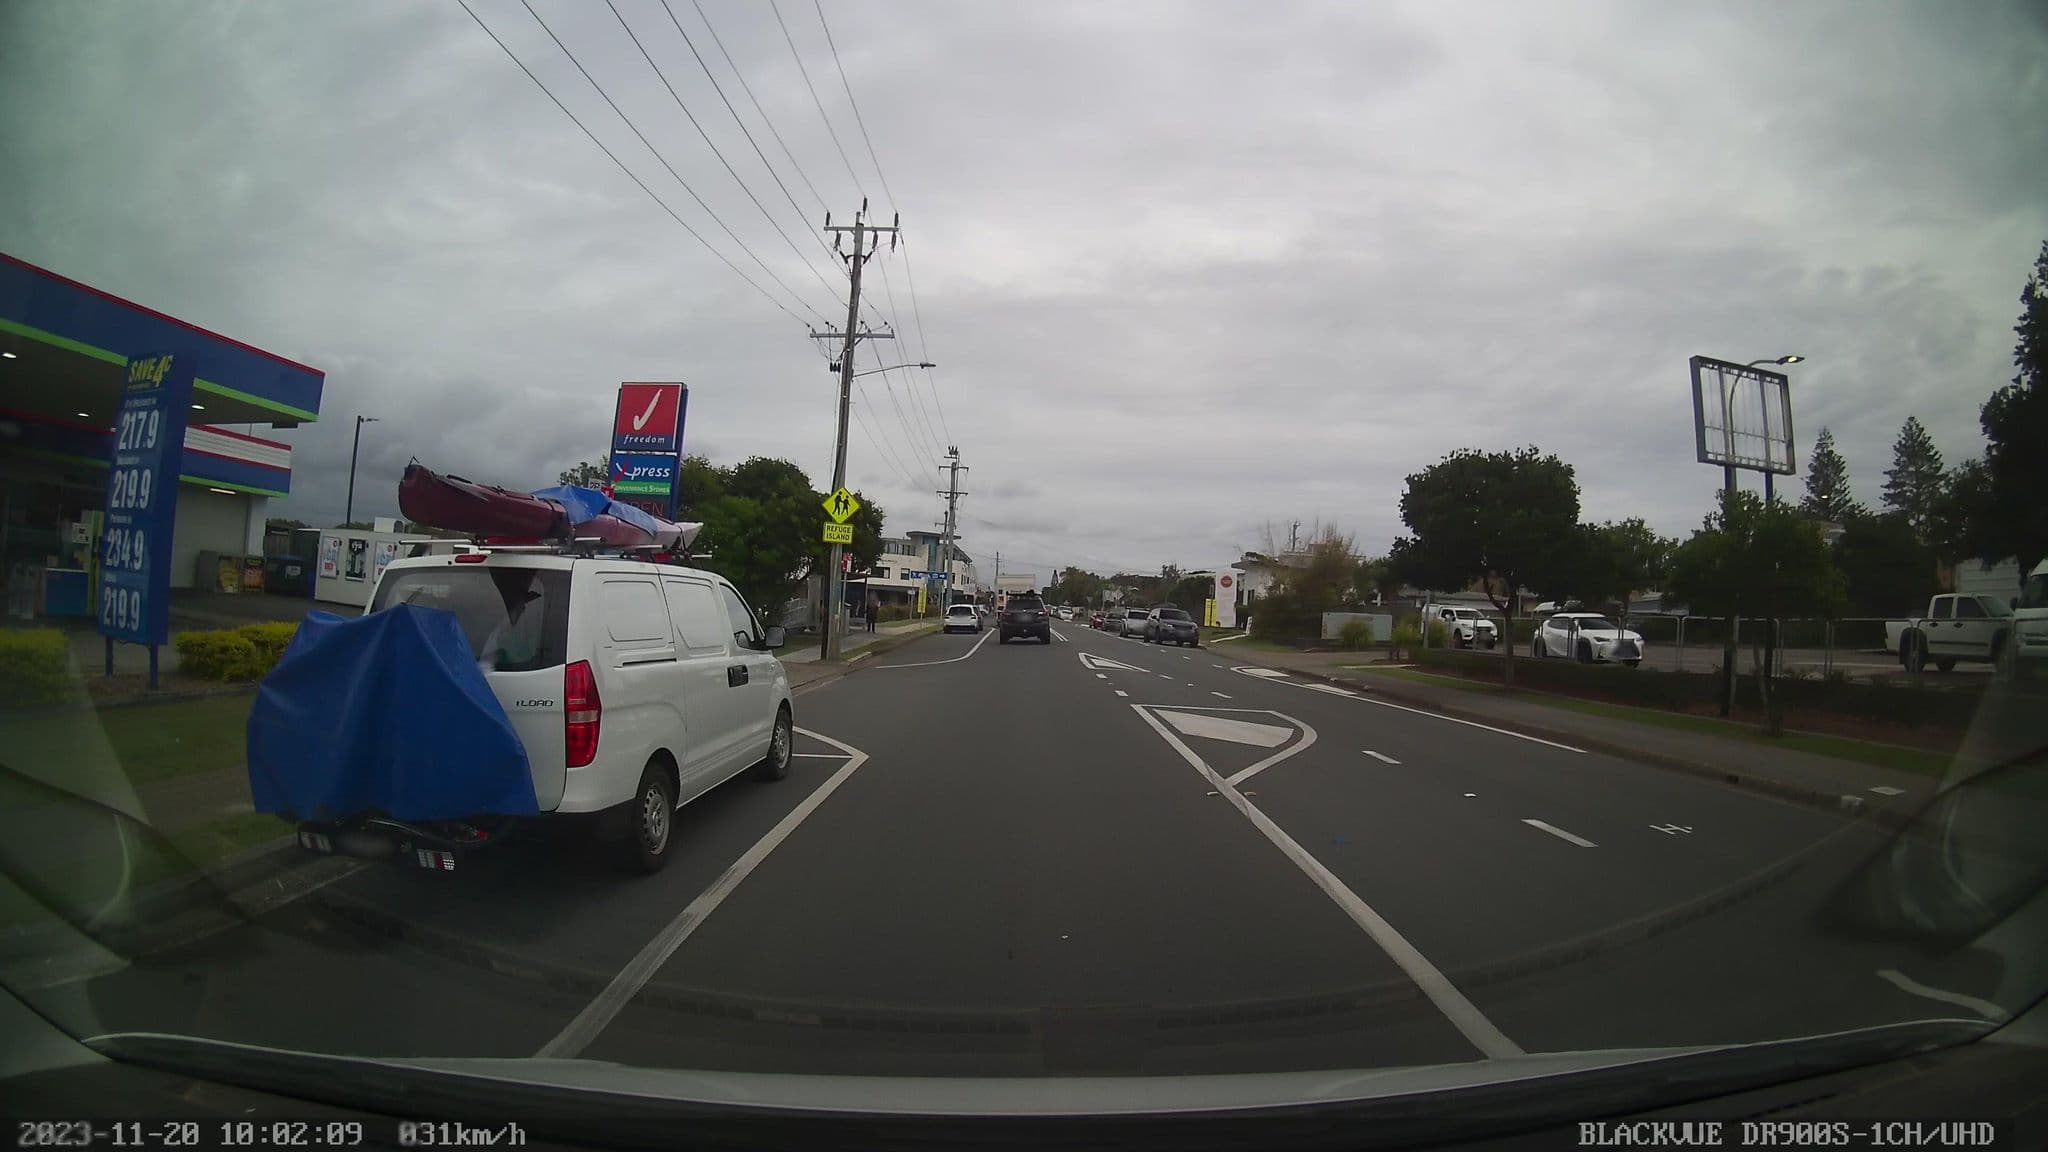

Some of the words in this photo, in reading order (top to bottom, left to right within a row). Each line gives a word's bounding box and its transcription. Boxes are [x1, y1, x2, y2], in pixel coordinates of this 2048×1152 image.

[128, 358, 157, 382] SAVE
[118, 409, 160, 450] 217.9
[624, 434, 665, 445] freedom
[112, 469, 151, 509] 219.9
[826, 525, 851, 534] REFUGE
[826, 532, 850, 541] ISLAND
[106, 528, 144, 571] 234.9
[103, 586, 140, 631] 219.9
